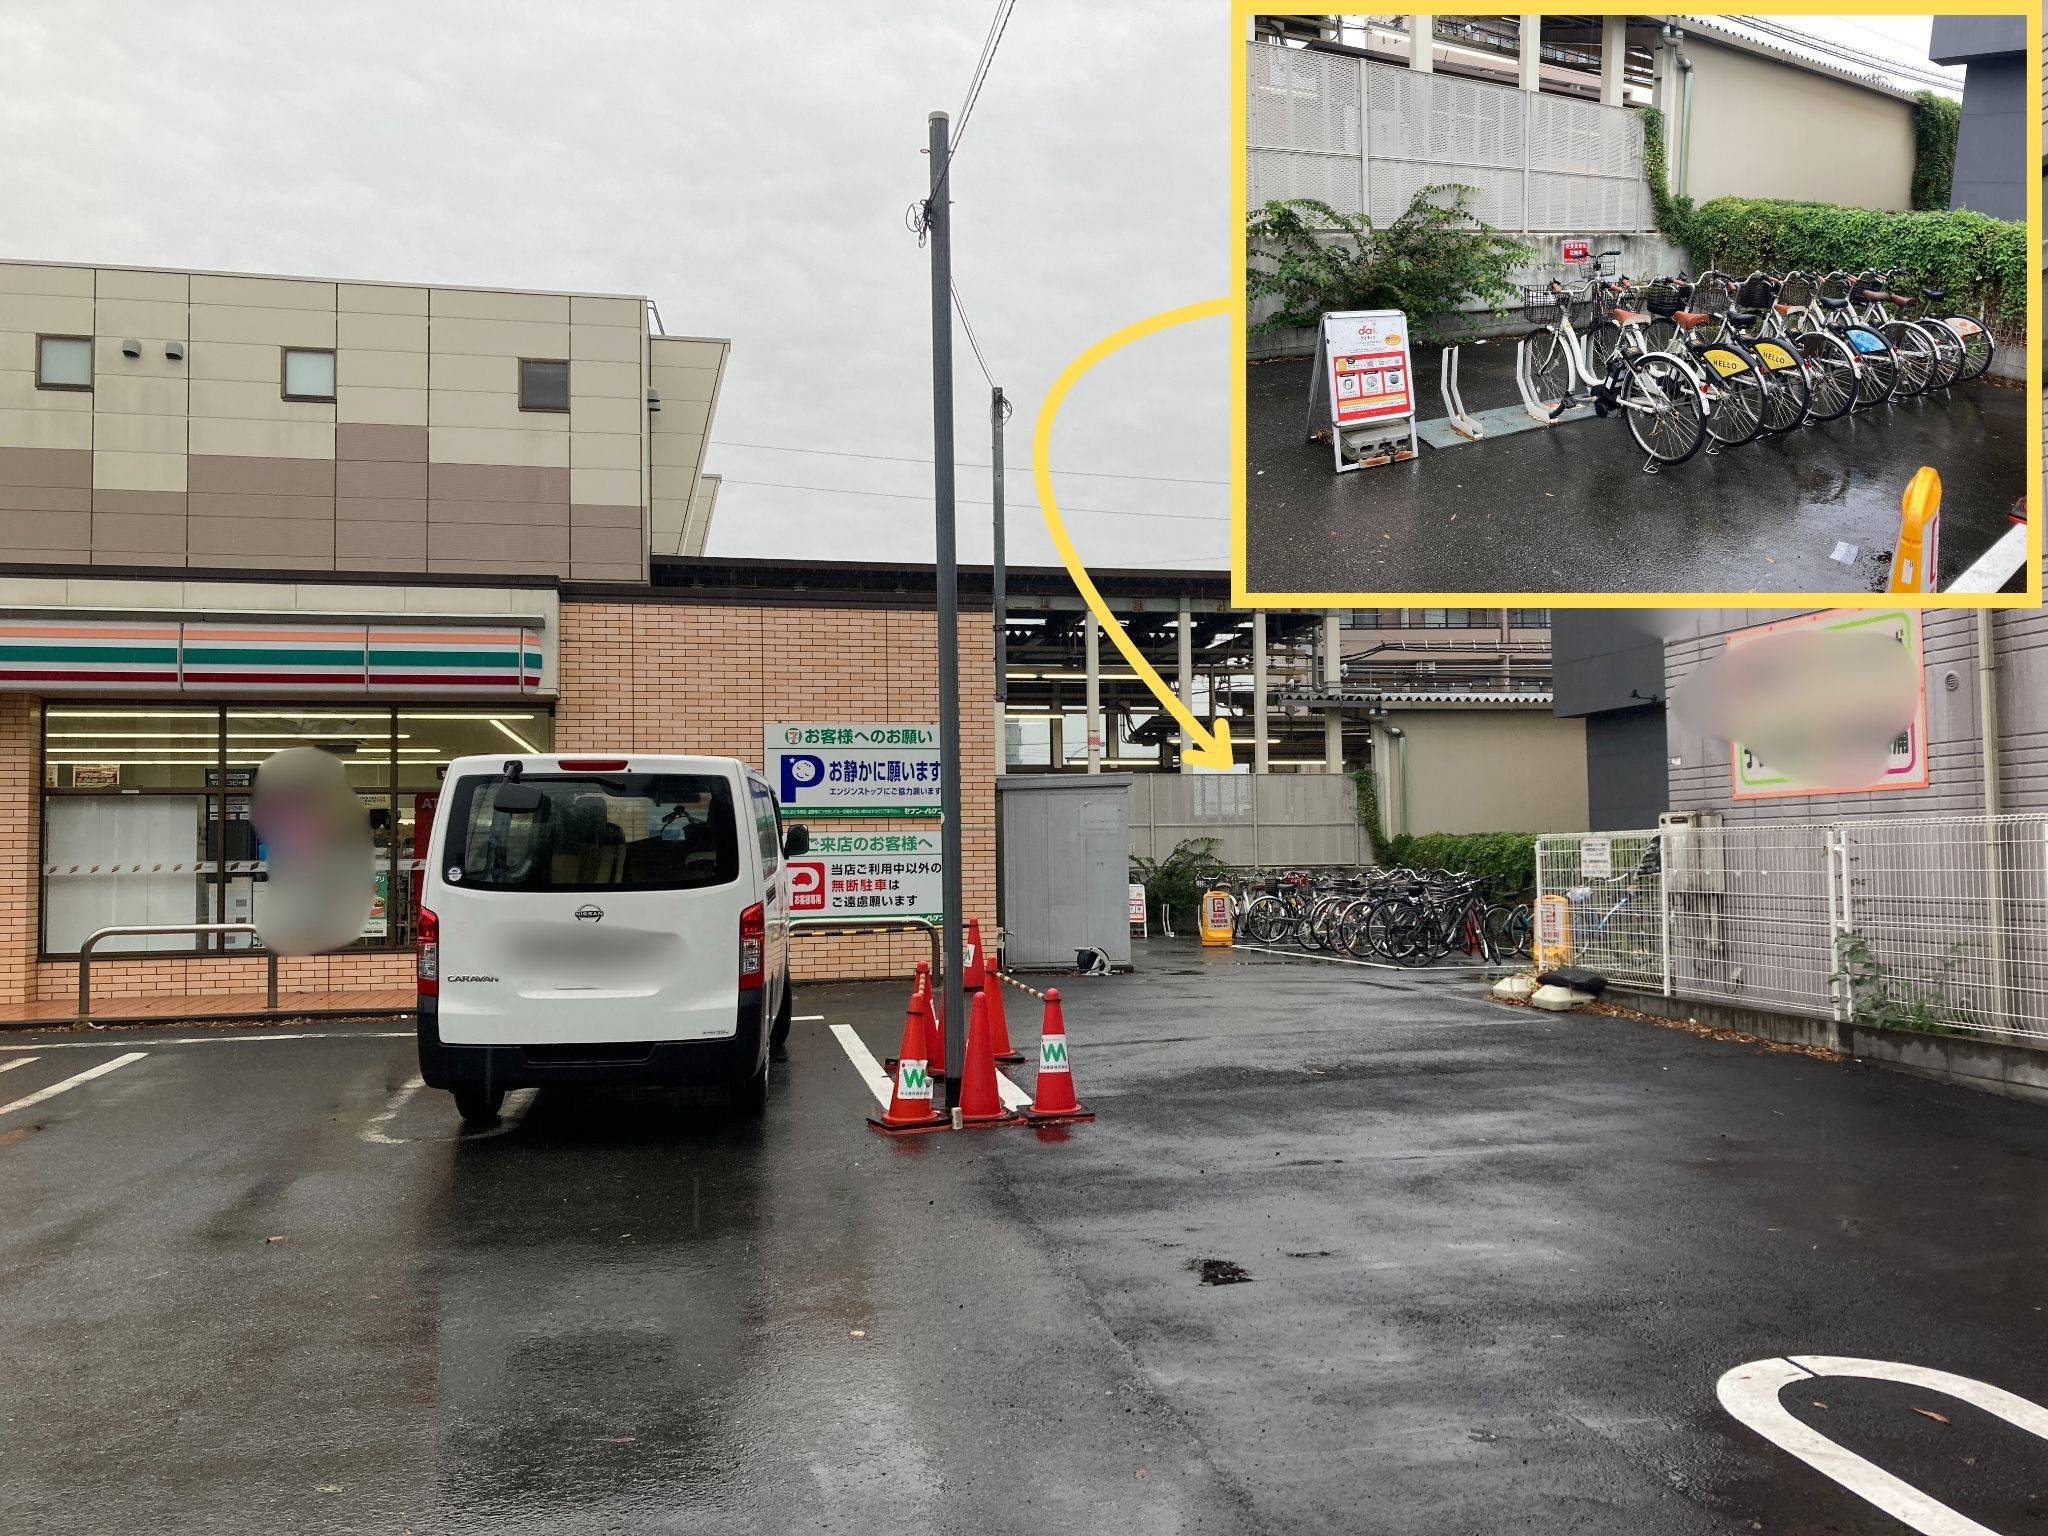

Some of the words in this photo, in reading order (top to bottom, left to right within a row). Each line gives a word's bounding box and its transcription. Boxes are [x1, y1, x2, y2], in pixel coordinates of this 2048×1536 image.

[1763, 351, 1785, 364] HELLO
[1713, 359, 1737, 370] HELLO
[805, 728, 933, 745] お客様へのお願い
[829, 760, 941, 782] お静かに願います
[829, 787, 941, 796] エンジンストップにご協力願います
[808, 836, 933, 852] ご来店のお客様へ
[831, 862, 941, 876] 当店ご利用中以外の
[831, 879, 900, 891] 無断駐車は
[832, 895, 918, 908] ご遠慮願います
[447, 975, 499, 983] CARAVAN
